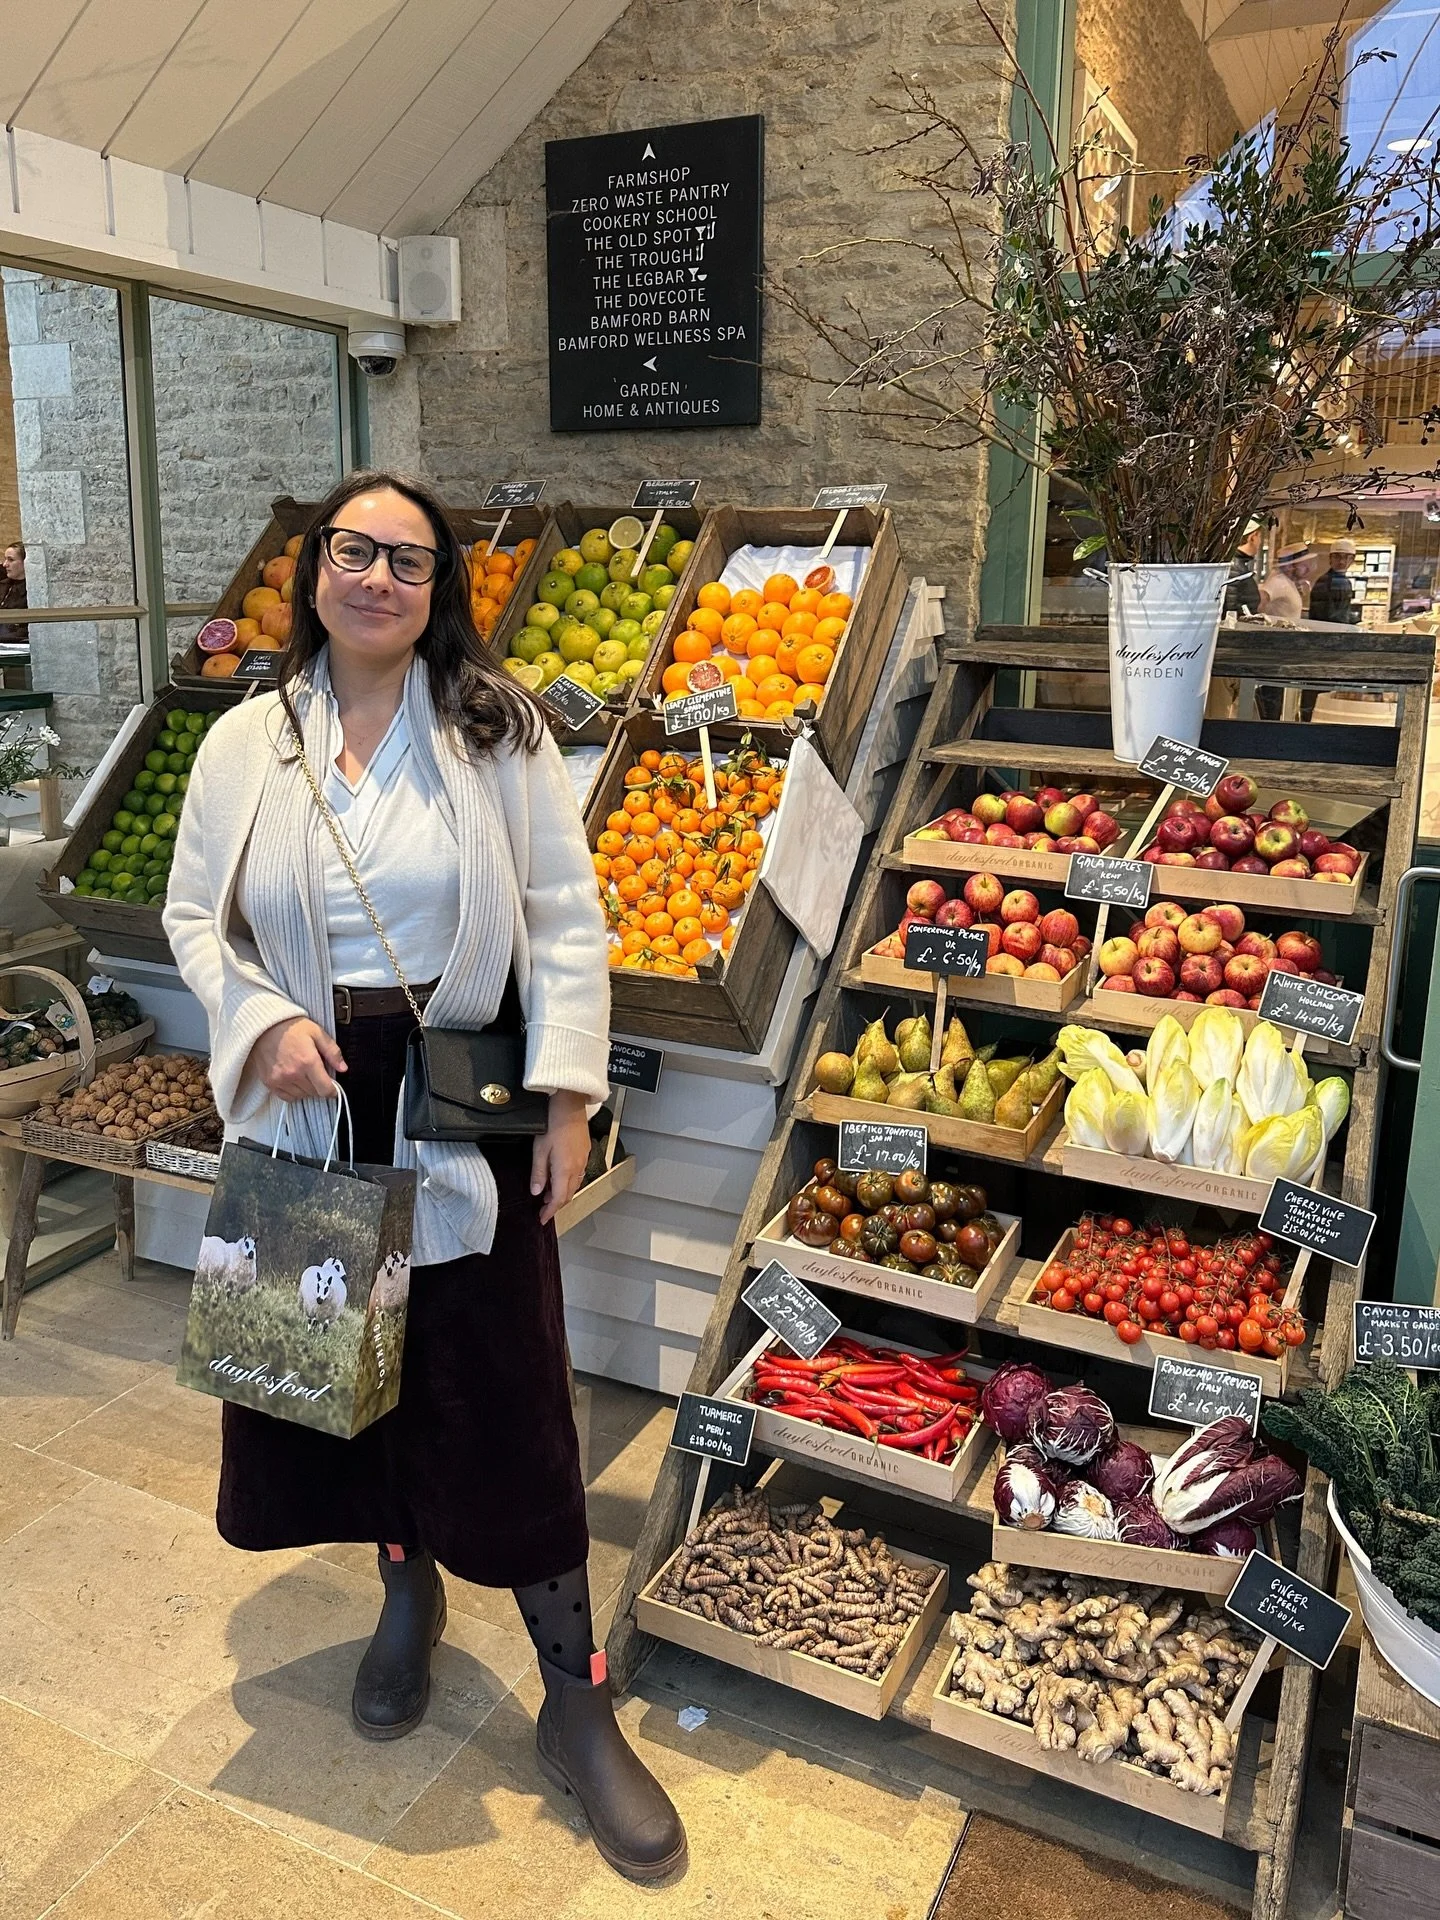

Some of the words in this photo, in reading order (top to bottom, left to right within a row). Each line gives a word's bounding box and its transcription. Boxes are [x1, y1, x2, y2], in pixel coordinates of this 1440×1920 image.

[608, 167, 690, 189] FARMSHOP
[572, 197, 609, 213] ZERO
[614, 190, 663, 210] WASTE
[670, 182, 730, 203] PANTRY
[583, 211, 650, 232] COOKERY
[656, 205, 718, 225] SCHOOL
[585, 235, 613, 252] THE
[618, 232, 647, 249] OLD
[653, 228, 692, 245] SPOT
[596, 254, 624, 270] THE
[630, 248, 692, 267] TROUGH
[593, 275, 621, 290] THE
[627, 270, 684, 288] LEGBAR
[595, 294, 622, 310] THE
[629, 288, 706, 308] DOVECOTE
[591, 312, 662, 330] BAMFORD
[669, 308, 710, 324] BARN
[558, 334, 629, 351] BAMFORD
[634, 328, 710, 346] WELLNESS
[717, 326, 746, 340] SPA
[620, 381, 680, 398] GARDEN
[583, 402, 624, 418] HOME
[630, 403, 639, 417] &
[645, 400, 720, 416] ANTIQUES
[1116, 642, 1203, 665] daylesford
[1125, 666, 1184, 678] GARDEN
[666, 699, 686, 710] LEAFY
[687, 686, 732, 706] CLEMENTINE
[1162, 740, 1195, 756] SPARTAN
[1174, 755, 1188, 765] UK
[946, 851, 1016, 866] daylesford
[1013, 860, 1053, 870] ORGANIC
[1076, 856, 1104, 868] GALA
[1108, 860, 1142, 872] APPLES
[1100, 872, 1122, 880] KENT
[908, 925, 955, 936] CONFERENCE
[958, 928, 984, 941] PEARS
[946, 940, 956, 950] UK
[1273, 974, 1305, 992] WHITE
[1307, 984, 1356, 1006] CHICORY
[1298, 996, 1334, 1010] HOLLAND
[612, 1045, 646, 1058] AVOCADO
[845, 1124, 882, 1134] IBERIKO
[884, 1126, 922, 1138] TOMATOES
[1120, 1166, 1208, 1190] daylesford
[1206, 1184, 1257, 1200] ORGANIC
[1284, 1192, 1320, 1213] CHERRY
[1322, 1206, 1346, 1220] VINE
[1289, 1204, 1332, 1227] TOMATOES
[1316, 1226, 1340, 1238] WIGHT
[802, 1261, 879, 1286] daylesford
[878, 1281, 922, 1298] ORGANIC
[780, 1274, 817, 1310] CHILLIES
[1362, 1306, 1410, 1318] CAVOLO
[1371, 1320, 1408, 1329] MARKET
[209, 1354, 332, 1402] daylesford
[1161, 1360, 1213, 1380] RADICCHIO
[1216, 1372, 1257, 1390] TREVISO
[1196, 1382, 1222, 1395] ITALY
[700, 1405, 742, 1424] TURMERIC
[706, 1424, 724, 1436] PERU
[774, 1427, 854, 1457] daylesford
[852, 1451, 900, 1474] ORGANIC
[1271, 1578, 1308, 1609] GINGER
